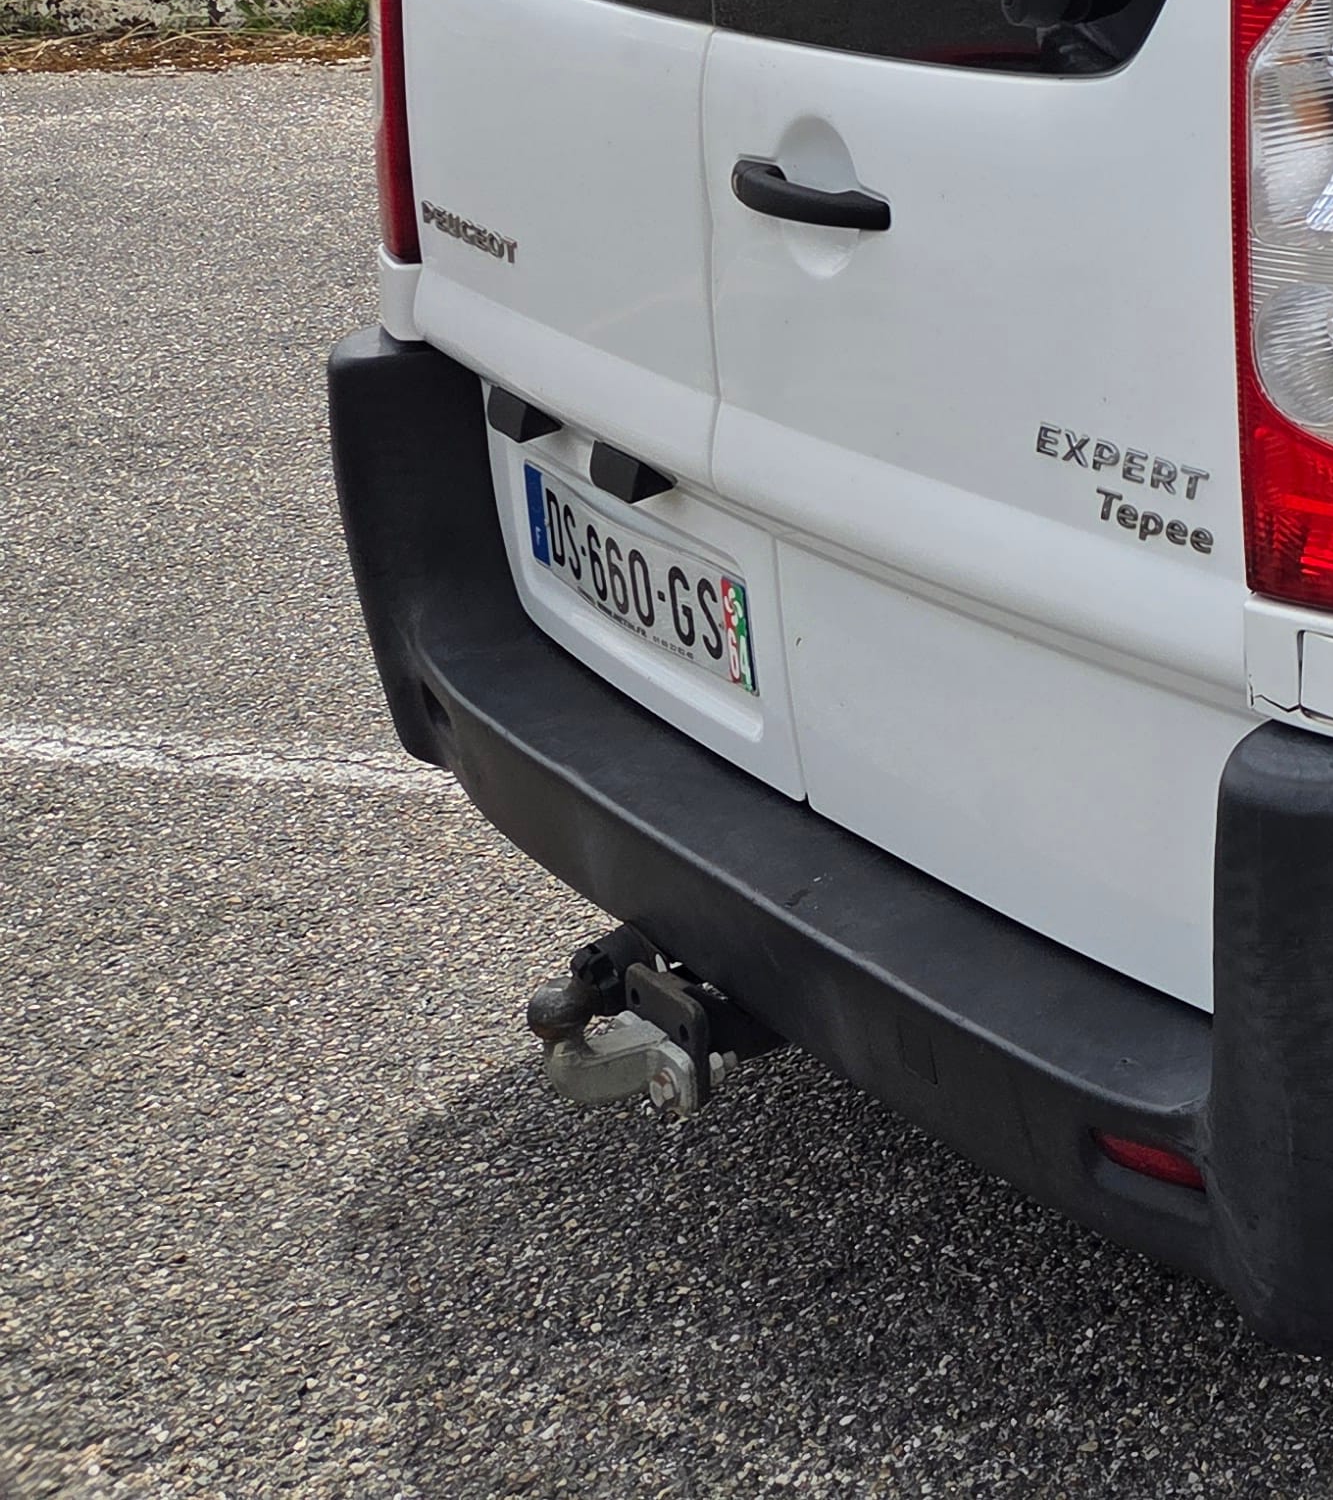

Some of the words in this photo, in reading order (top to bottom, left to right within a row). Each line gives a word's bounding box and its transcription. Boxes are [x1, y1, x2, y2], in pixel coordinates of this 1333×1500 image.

[421, 200, 518, 264] PEUGEOT
[1036, 422, 1210, 500] EXPERT
[1096, 486, 1214, 555] Tepee
[546, 488, 723, 660] DS-660-GS
[727, 627, 752, 686] 64
